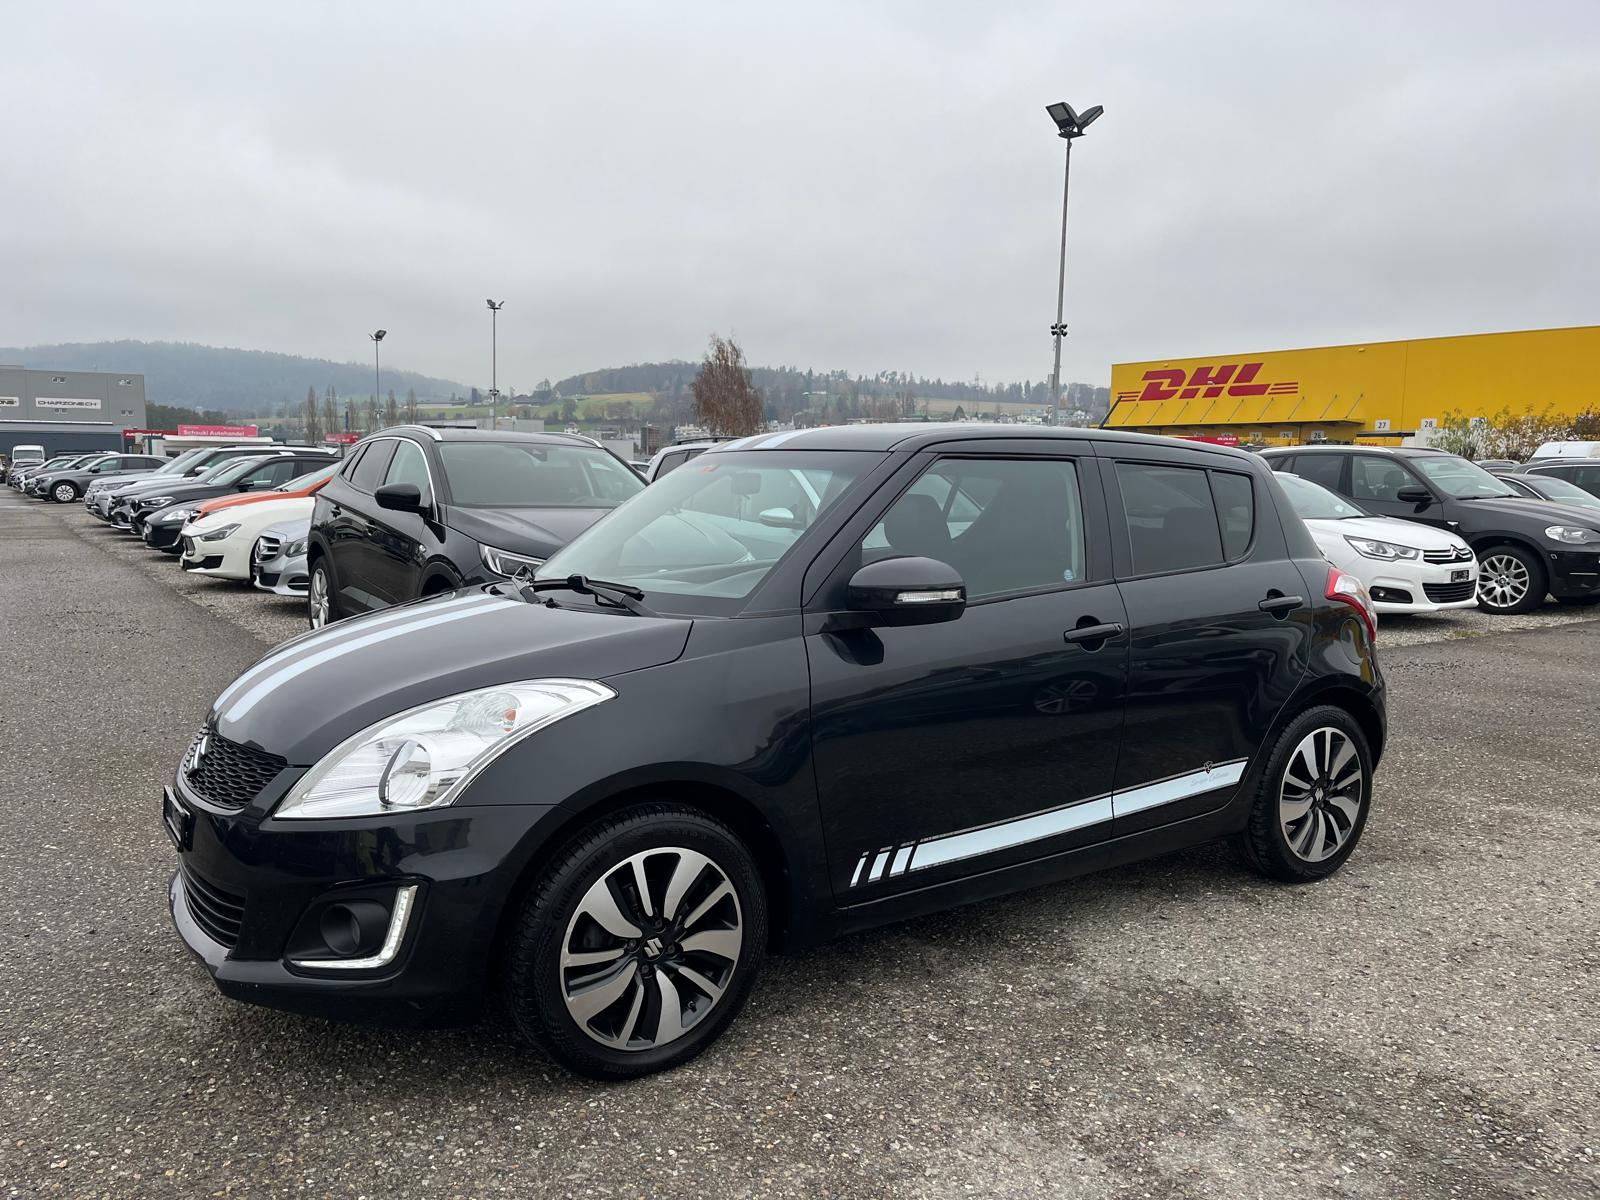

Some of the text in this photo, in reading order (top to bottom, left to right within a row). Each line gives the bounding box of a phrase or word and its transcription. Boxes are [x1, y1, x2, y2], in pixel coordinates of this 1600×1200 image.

[1138, 362, 1271, 401] DHL
[1378, 421, 1387, 429] 27
[1424, 420, 1433, 428] 28
